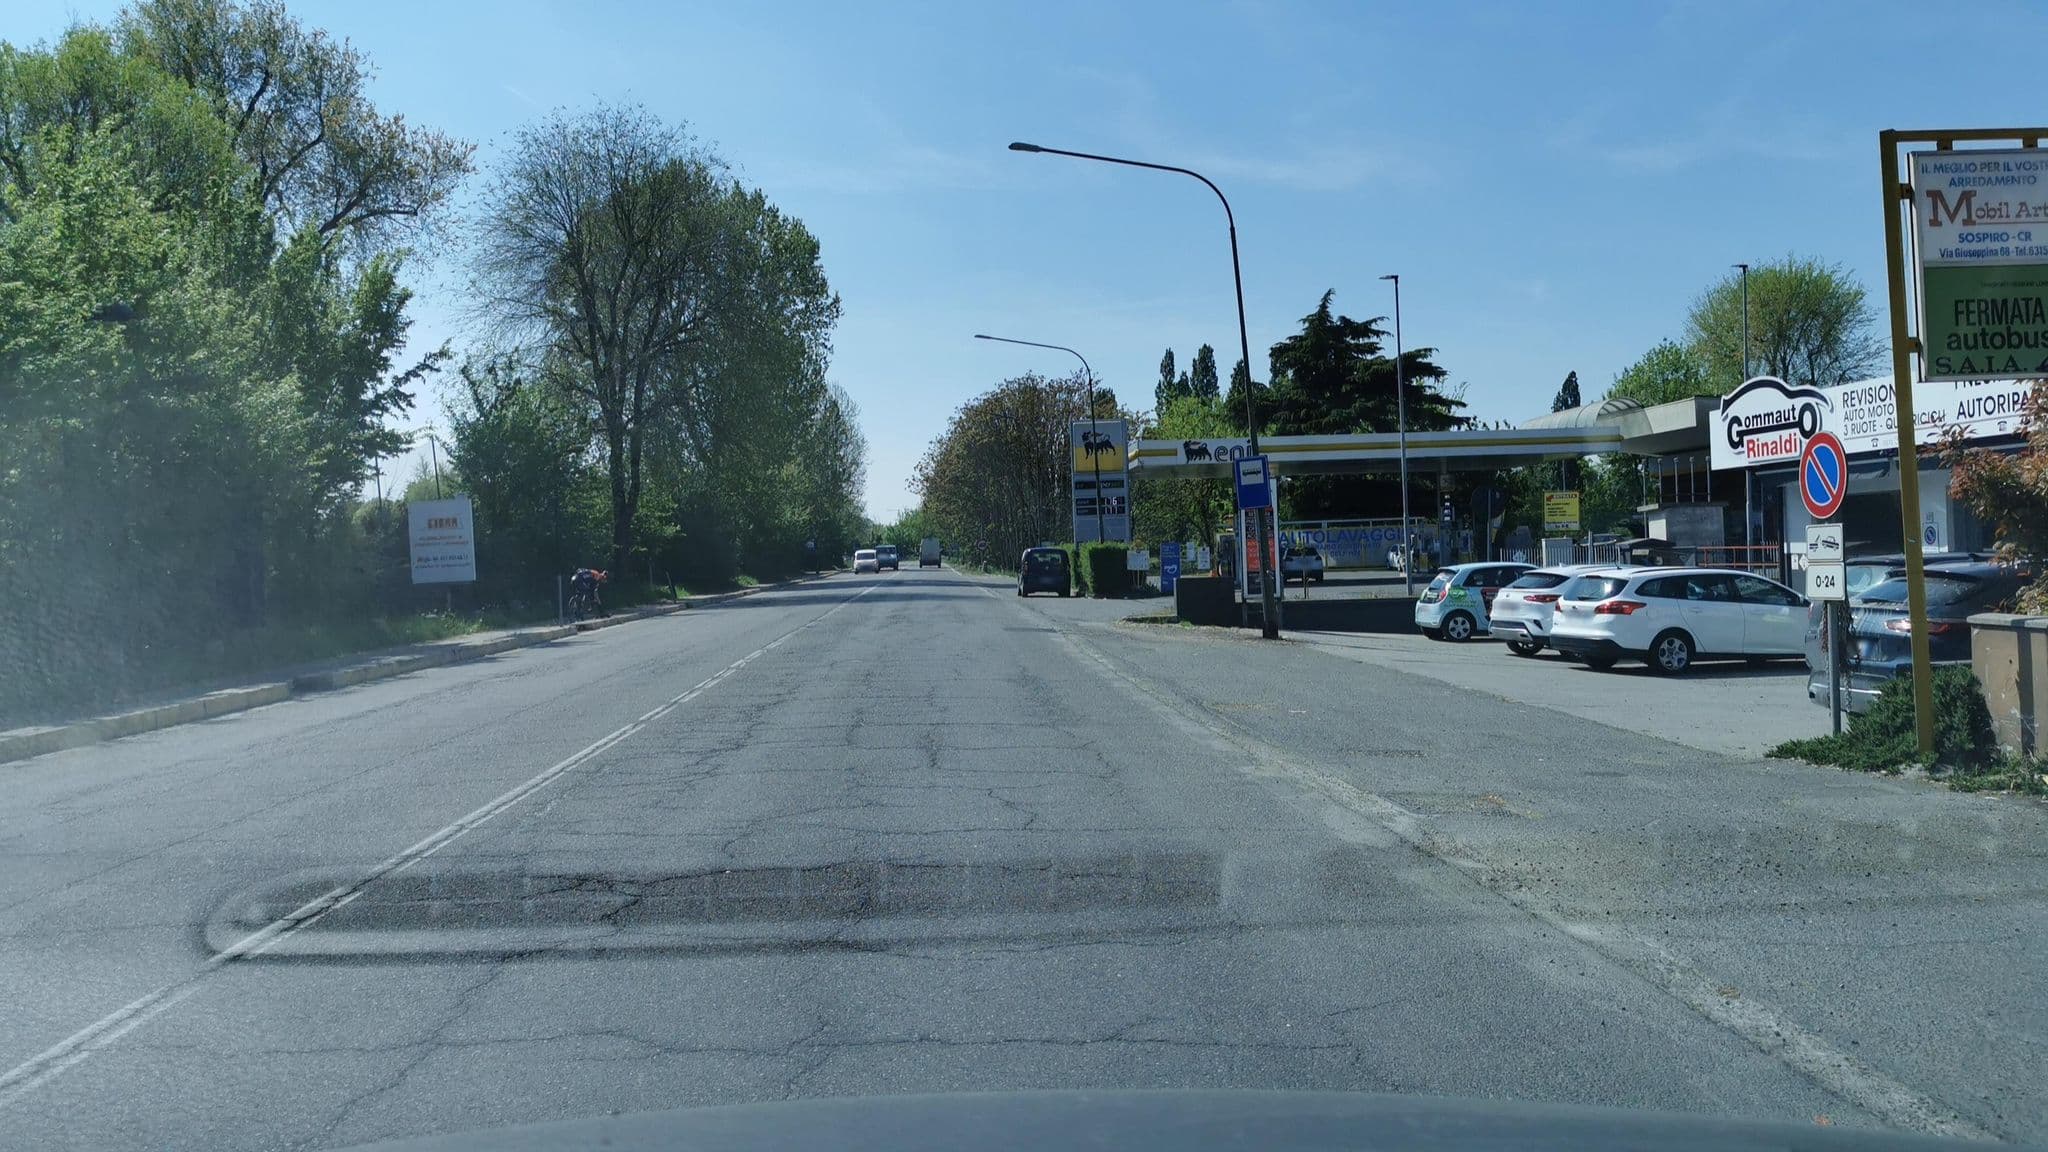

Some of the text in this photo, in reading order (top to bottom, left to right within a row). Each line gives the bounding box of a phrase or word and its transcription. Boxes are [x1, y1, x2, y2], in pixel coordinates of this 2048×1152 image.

[1921, 163, 1931, 174] IL
[1933, 162, 1978, 174] MEGLIO
[1980, 161, 2000, 173] PER
[2003, 160, 2013, 172] IL
[1949, 174, 2037, 188] ARREDAMENTO
[1926, 189, 2011, 227] Mobil
[1958, 231, 2010, 244] SOSPIRO
[2018, 231, 2033, 242] CR
[1939, 247, 1954, 259] Via
[1954, 245, 1999, 259] Giuseppina
[1954, 297, 2046, 327] FERMATA
[1946, 325, 2048, 351] autobus
[1935, 355, 2028, 375] S.A.I.A.
[1842, 383, 1897, 409] REVISION
[1956, 390, 2030, 420] AUTORIPA
[1844, 403, 1895, 423] AUTO MOTO
[1843, 424, 1849, 436] 3
[1851, 420, 1877, 435] RUOTE
[1214, 438, 1252, 463] eni
[1746, 432, 1798, 459] Rinaldi
